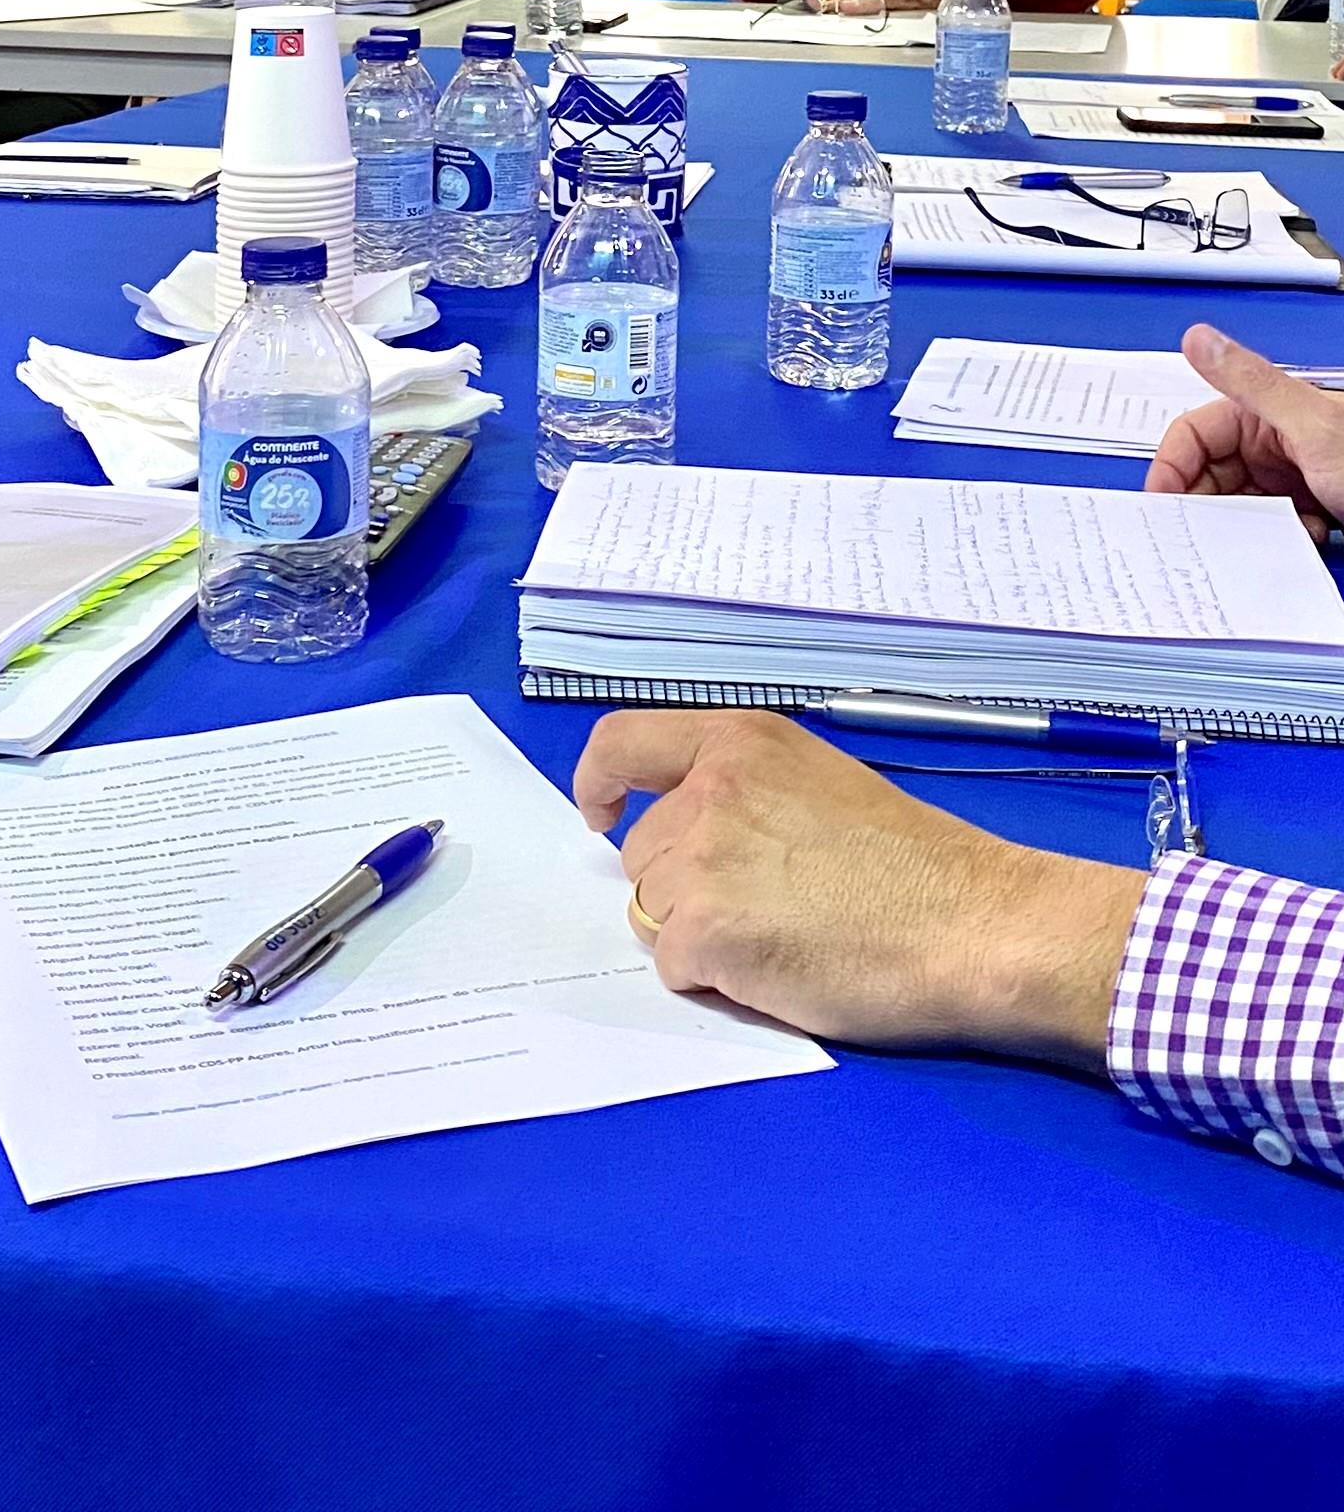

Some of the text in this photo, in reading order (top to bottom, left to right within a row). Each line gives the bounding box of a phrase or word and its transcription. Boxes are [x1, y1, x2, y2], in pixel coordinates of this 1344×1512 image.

[820, 289, 847, 300] 33 cl
[252, 440, 320, 452] CONTINENTE
[242, 450, 330, 465] Água de Nascente
